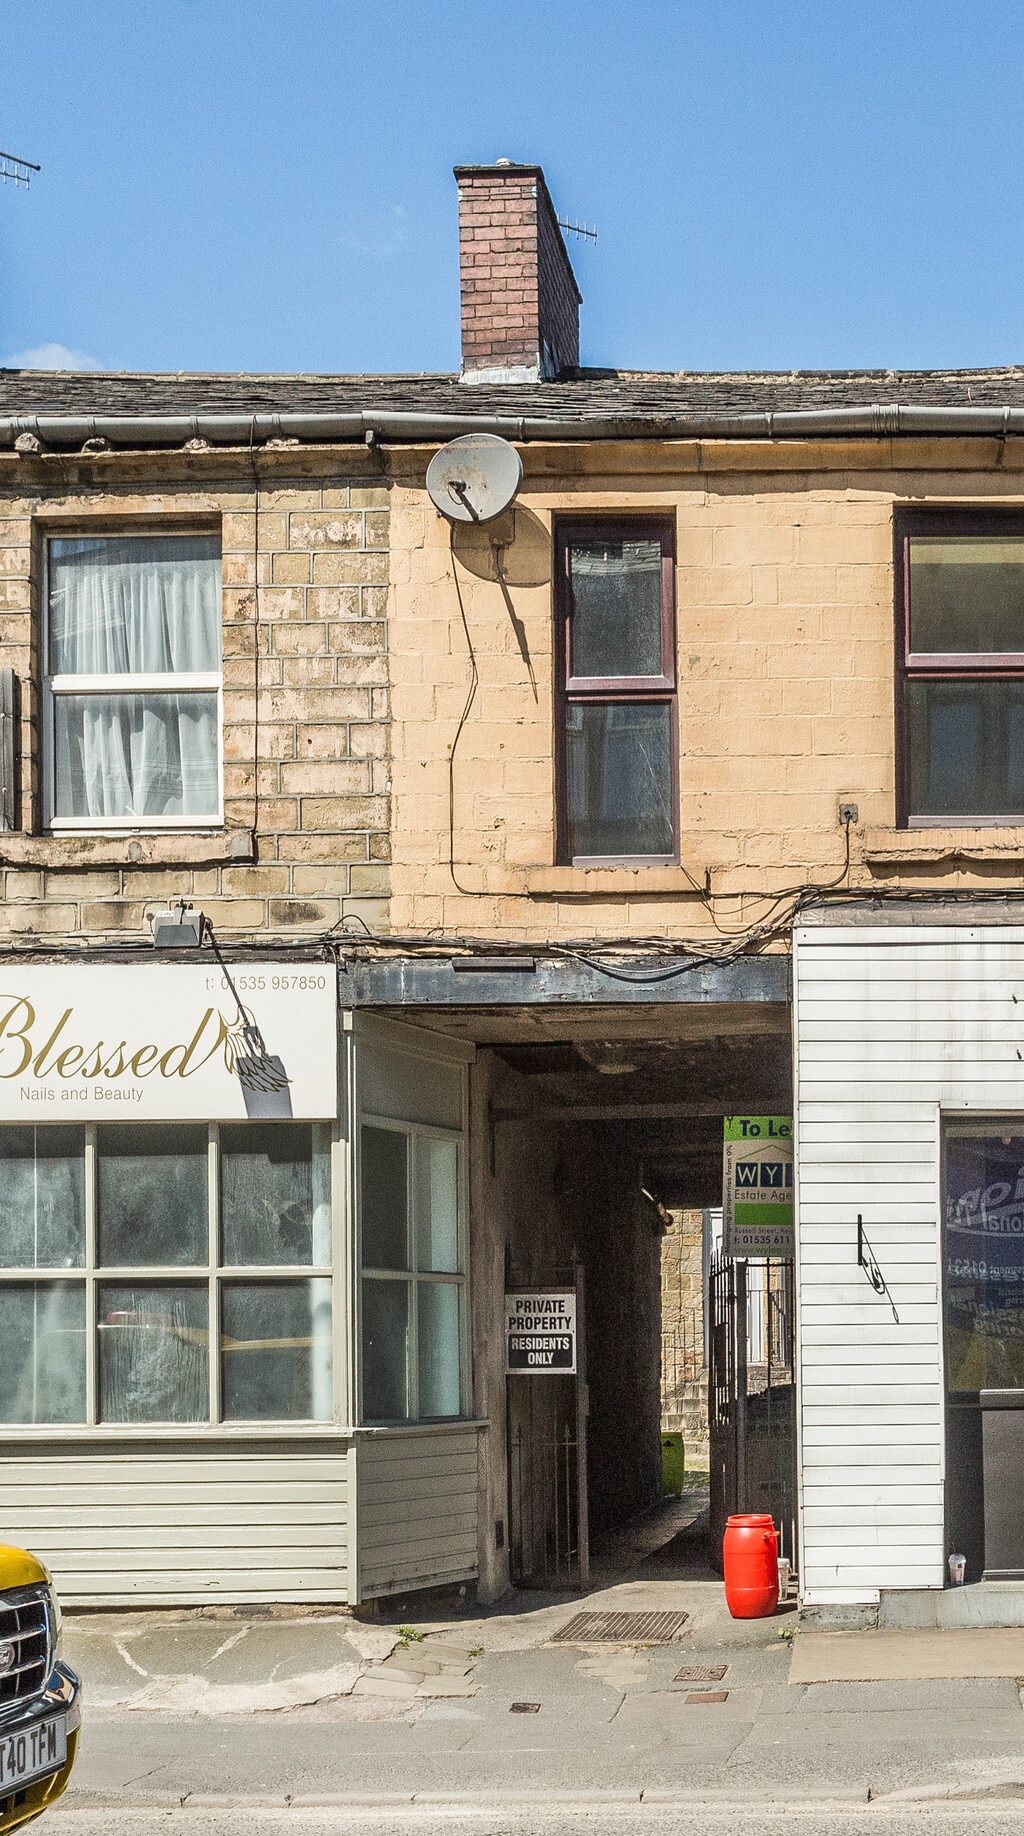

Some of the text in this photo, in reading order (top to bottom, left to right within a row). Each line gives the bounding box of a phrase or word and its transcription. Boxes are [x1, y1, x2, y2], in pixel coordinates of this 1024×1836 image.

[205, 976, 326, 990] t: 01535 957850
[0, 994, 218, 1079] Blessed
[20, 1086, 144, 1102] Nails and Beauty
[740, 1120, 791, 1137] To Le
[737, 1165, 779, 1185] WY
[735, 1189, 793, 1203] Estate Age
[743, 1235, 771, 1244] 01535
[516, 1300, 565, 1313] PRIVATE
[508, 1317, 572, 1330] PROPERTY
[511, 1337, 570, 1350] RESIDENTS
[527, 1352, 554, 1365] ONLY
[30, 1723, 56, 1768] TFM
